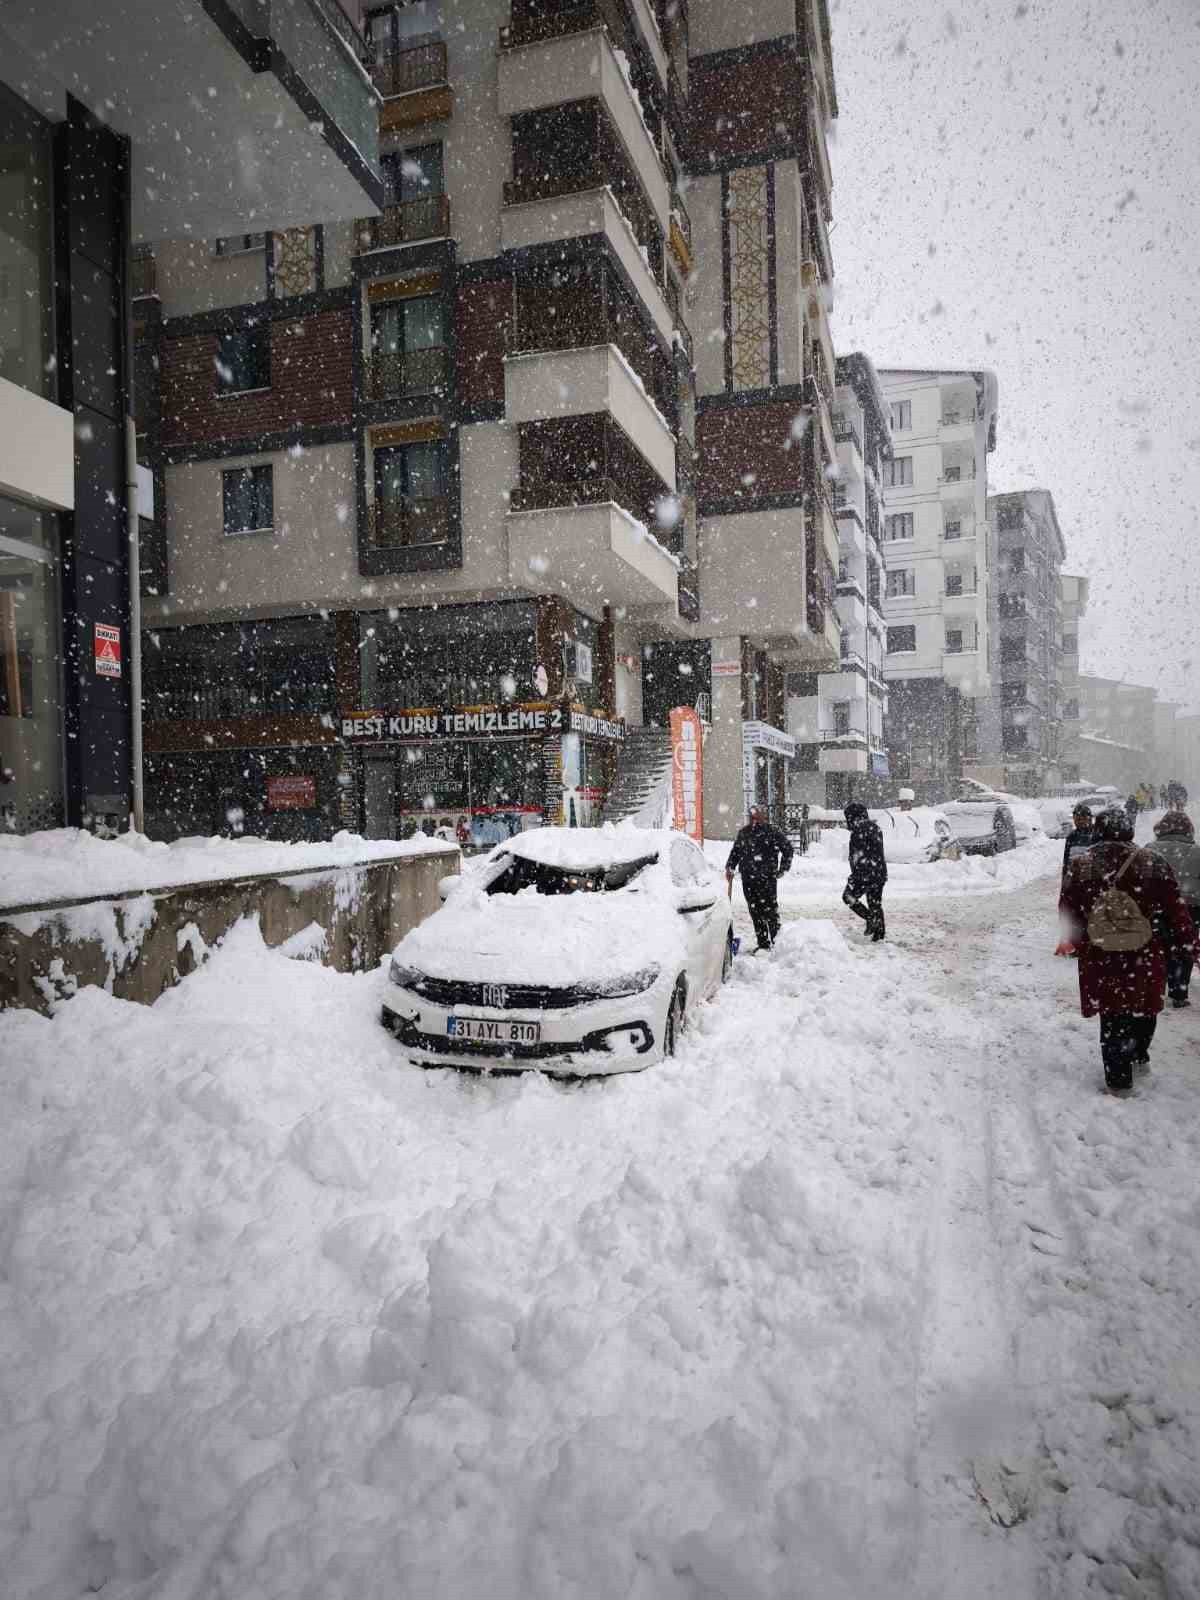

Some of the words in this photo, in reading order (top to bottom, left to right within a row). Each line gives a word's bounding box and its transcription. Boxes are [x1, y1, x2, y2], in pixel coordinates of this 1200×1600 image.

[342, 718, 384, 737] BEST
[389, 716, 438, 735] KURU
[551, 709, 562, 728] 2
[483, 985, 507, 1008] FIAT
[457, 1021, 471, 1036] 31
[477, 1023, 503, 1039] AYL
[510, 1025, 535, 1041] 810
